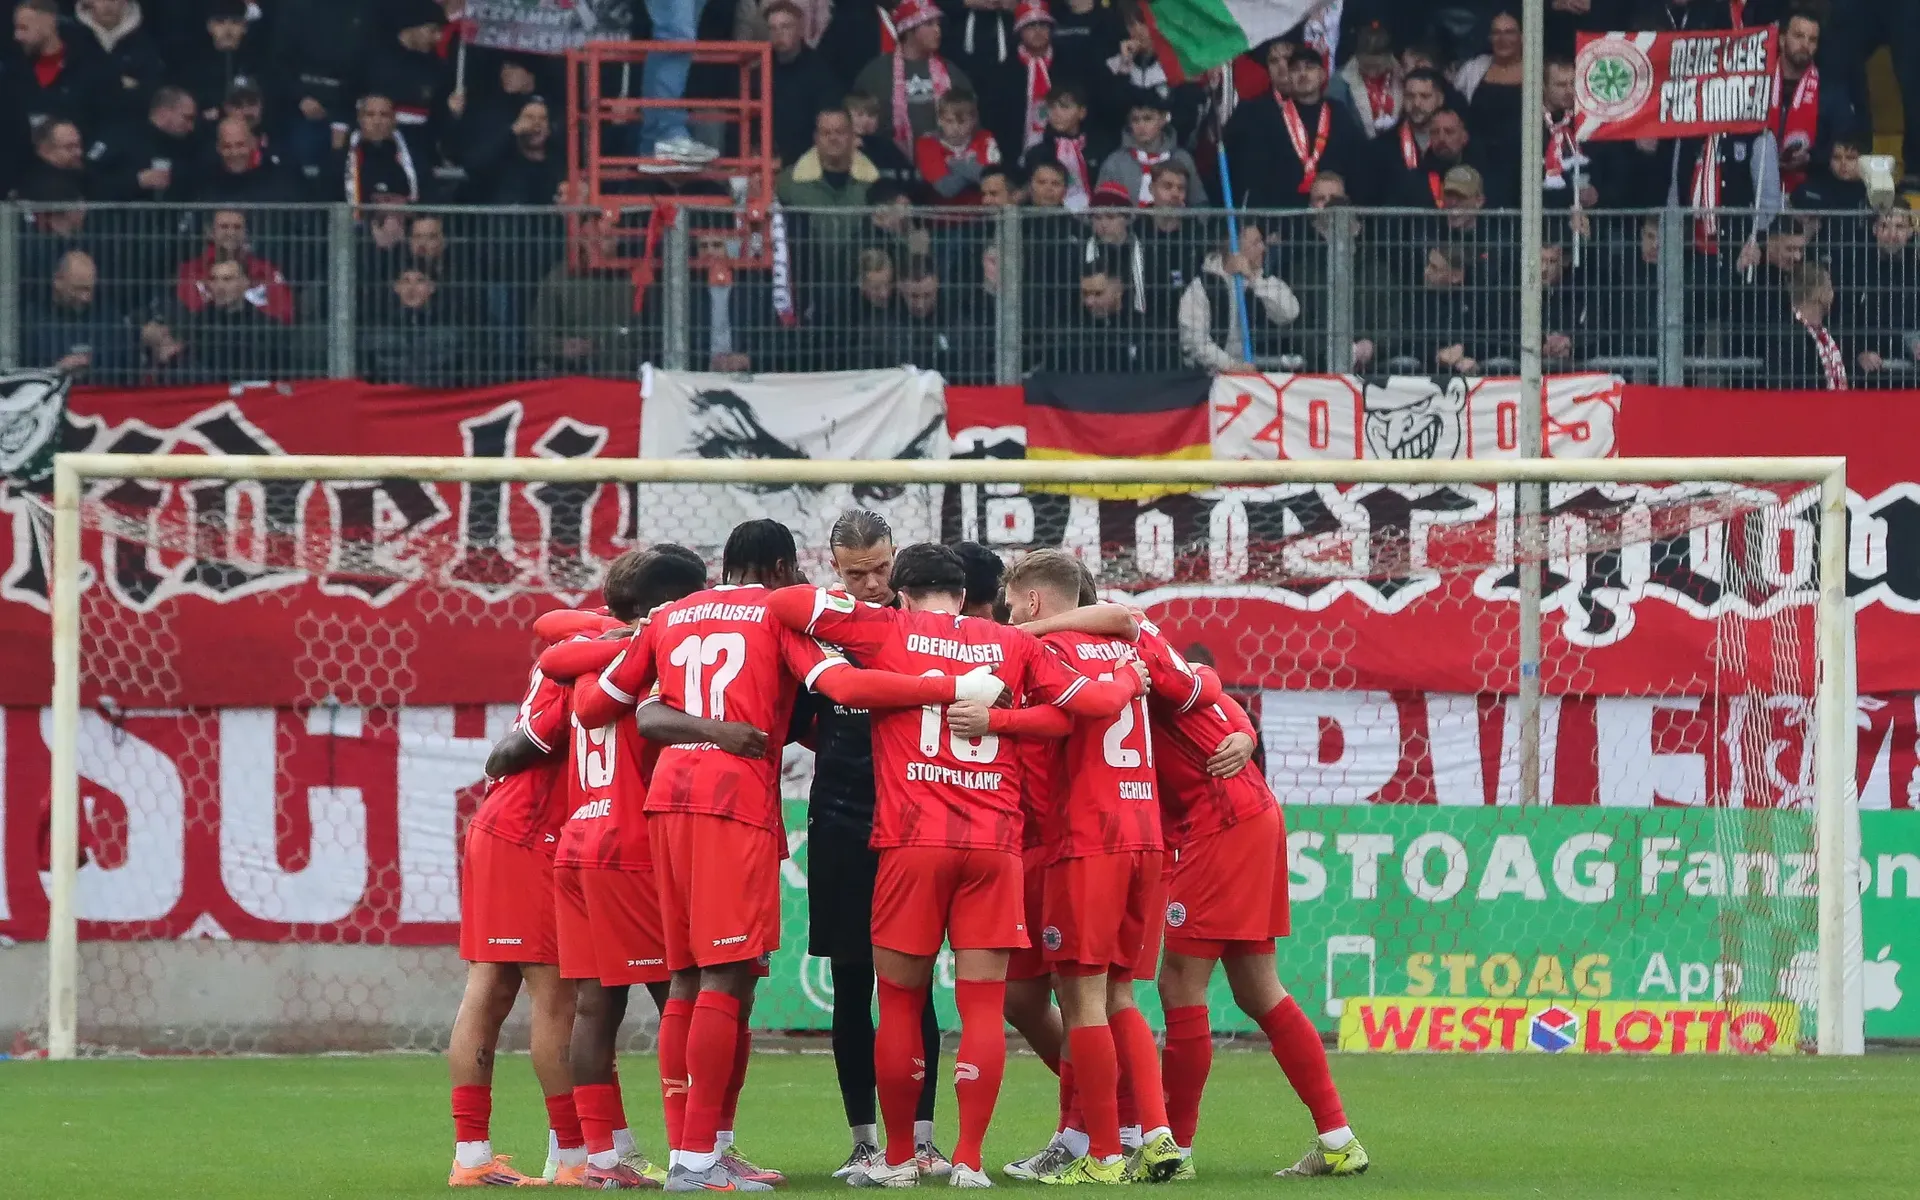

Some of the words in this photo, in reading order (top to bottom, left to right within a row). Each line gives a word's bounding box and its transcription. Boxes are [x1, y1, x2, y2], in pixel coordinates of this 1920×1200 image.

[1669, 37, 1721, 78] MEINE
[1723, 30, 1769, 73] LIEBE
[666, 602, 767, 628] OBERHAUSEN
[907, 633, 1005, 663] OBERHAUSEN
[906, 762, 1003, 790] STOPPELKAMP
[1286, 831, 1615, 904] STOAG
[720, 934, 748, 946] PATRICK
[635, 958, 664, 967] PATRICK
[1406, 953, 1612, 998] STOAG
